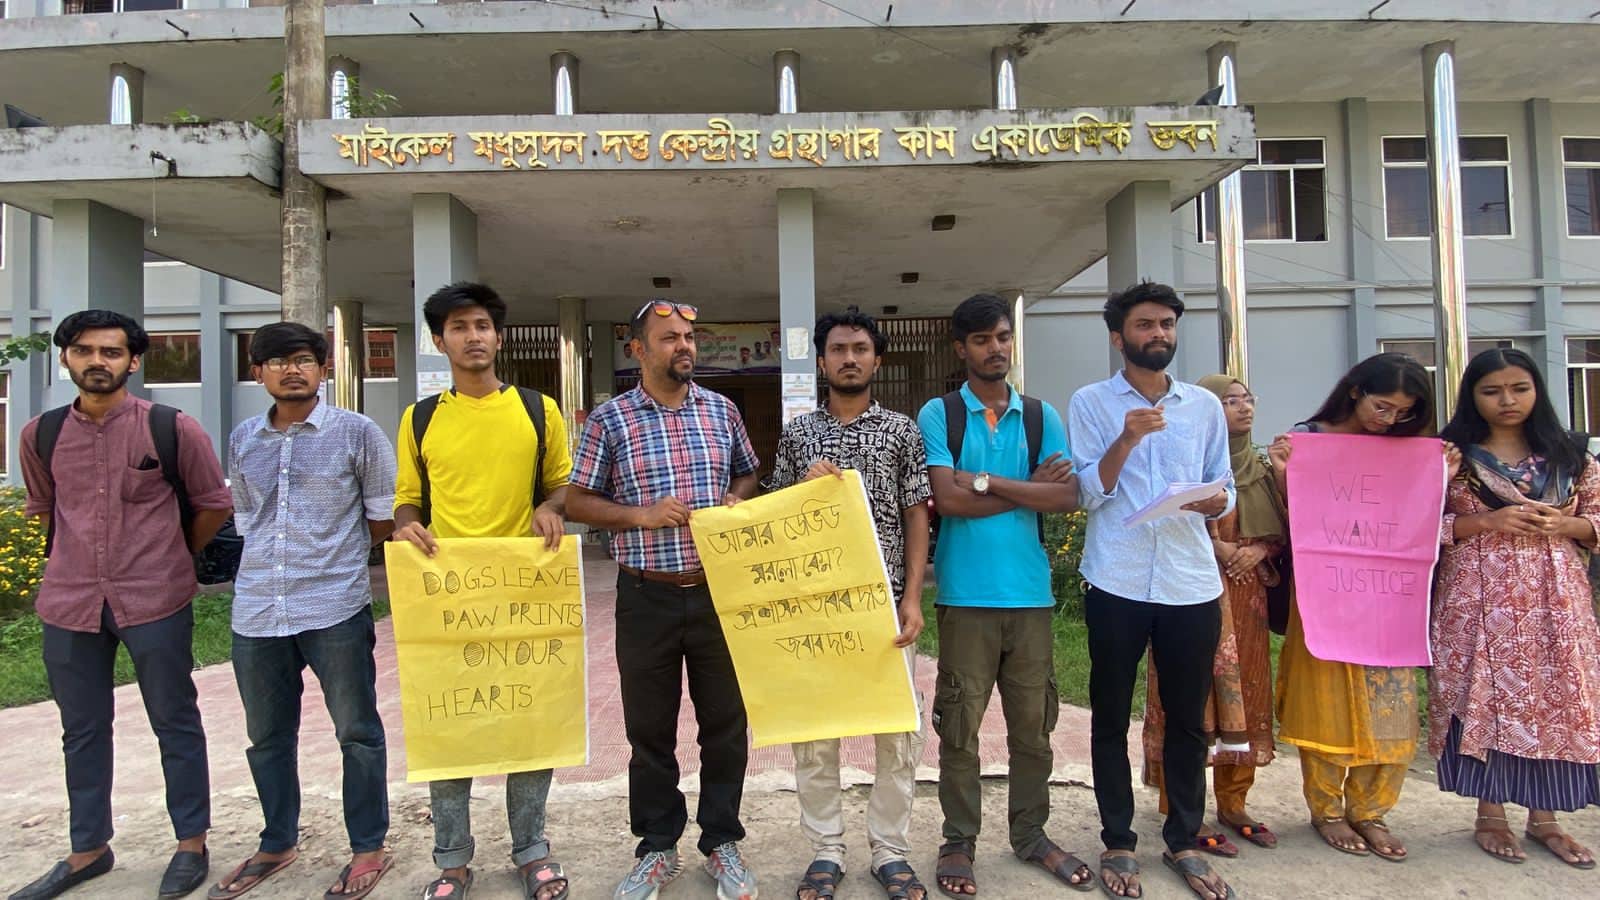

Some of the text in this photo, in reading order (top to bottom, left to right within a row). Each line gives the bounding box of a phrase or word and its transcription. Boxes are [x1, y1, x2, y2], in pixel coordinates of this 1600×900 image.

[334, 111, 1220, 169] মাইকেল মধুসূদন দত্ত কেন্দ্রীয় গ্রন্থাগার কাম একাডেমিক ভবন
[1329, 471, 1382, 505] WE
[707, 498, 841, 555] আমার ডেভিড
[1321, 515, 1399, 548] WANT
[422, 566, 580, 596] DOGS LEAVE
[744, 557, 800, 585] মরলো
[1326, 565, 1416, 596] JUSTICE
[443, 602, 584, 631] PAW PRINTS
[733, 597, 803, 631] প্রশাসন
[463, 638, 567, 667] ON OUR
[774, 633, 825, 660] জবাব
[427, 684, 534, 721] HEARTS
